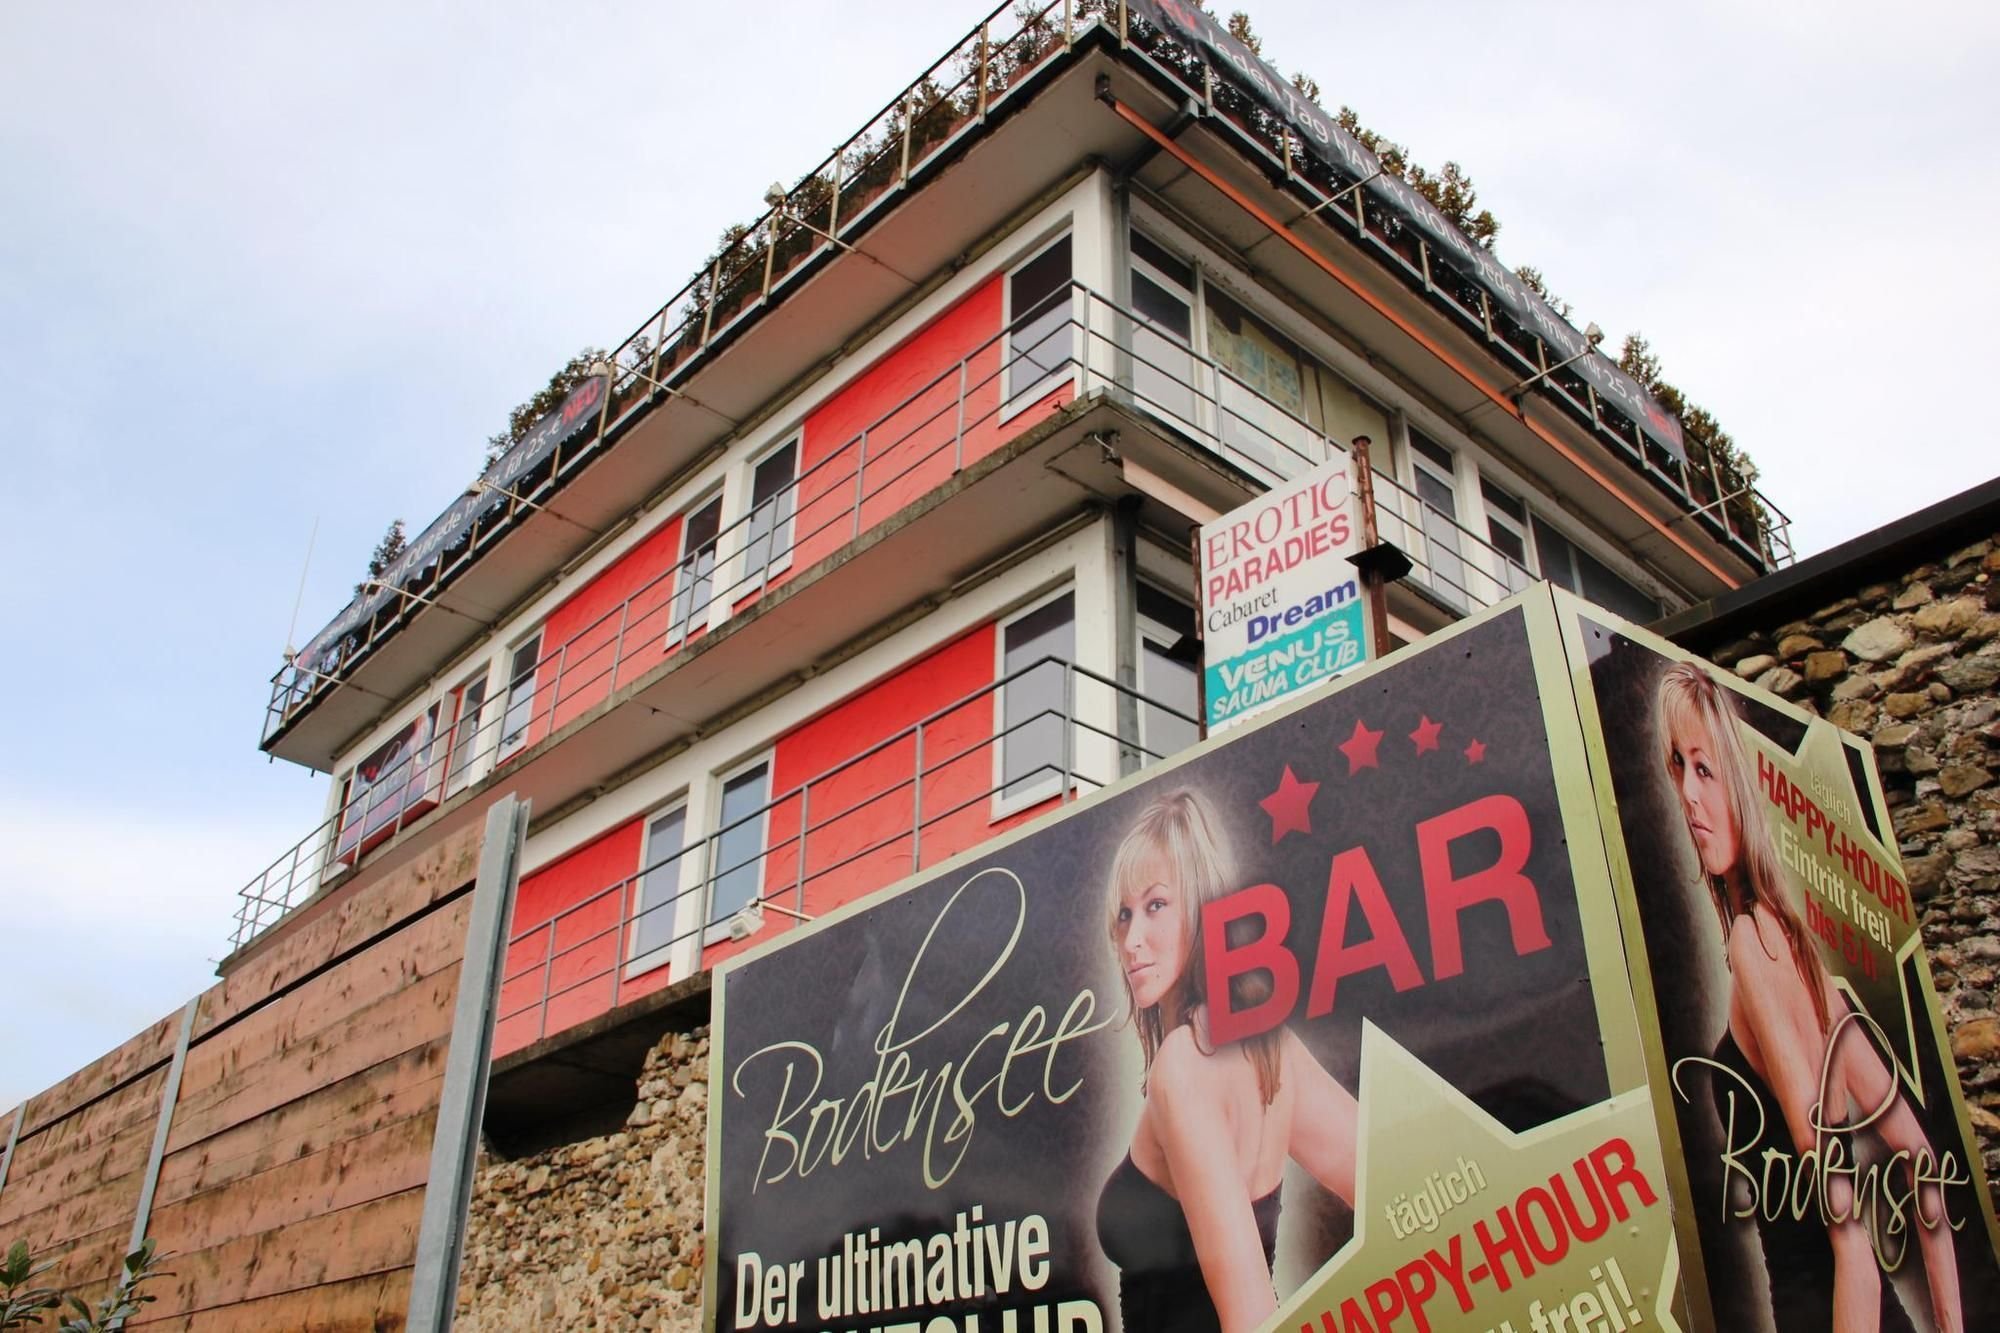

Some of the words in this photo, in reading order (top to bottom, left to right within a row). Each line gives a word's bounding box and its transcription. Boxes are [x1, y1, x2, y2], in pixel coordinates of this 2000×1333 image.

[1283, 88, 1329, 144] Tag
[561, 378, 601, 427] NEU
[1207, 471, 1350, 573] EROTIC
[1208, 513, 1351, 608] PARADIES
[1208, 586, 1278, 633] Cabaret
[1247, 579, 1357, 645] Dream
[1212, 675, 1290, 720] SAUNA
[1294, 640, 1358, 685] CLUB
[1218, 619, 1349, 692] VENUS
[1757, 750, 1910, 925] HAPPY-HOUR
[1810, 770, 1852, 826] täglich
[1200, 793, 1553, 1049] BAR
[1780, 822, 1848, 915] Eintritt
[1851, 888, 1893, 954] frei!
[1805, 888, 1839, 950] bis
[1841, 923, 1859, 967] 5
[732, 866, 1119, 1195] Bodensee
[1671, 1011, 1970, 1273] Bodensee
[1385, 1155, 1488, 1241] täglich
[735, 1251, 804, 1330] Der
[817, 1204, 1051, 1321] ultimative
